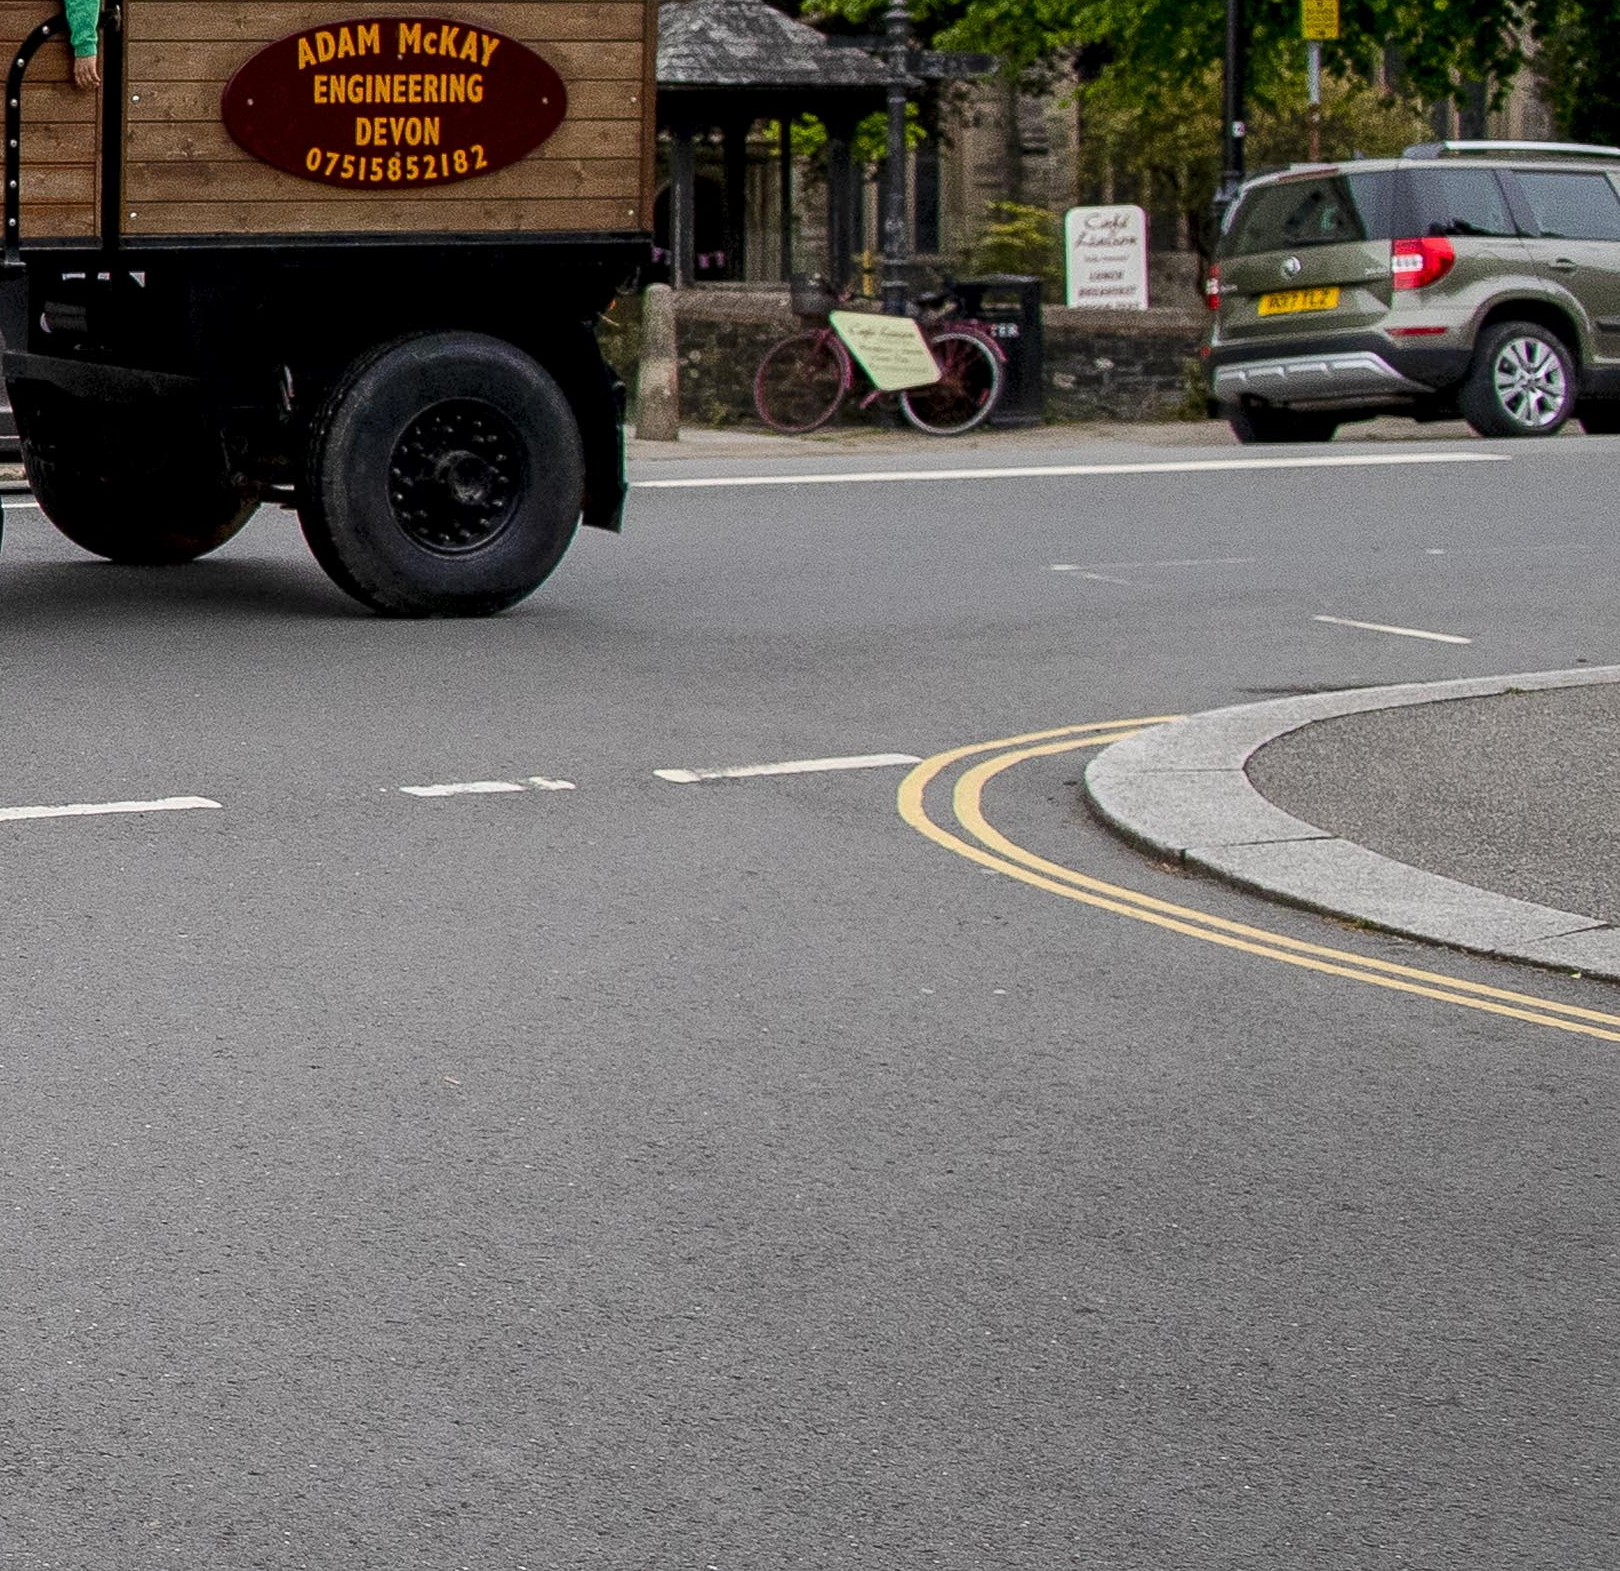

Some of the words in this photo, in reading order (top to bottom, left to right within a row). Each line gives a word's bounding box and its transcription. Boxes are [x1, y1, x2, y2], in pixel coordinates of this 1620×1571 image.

[298, 23, 380, 70] ADAM
[398, 23, 500, 67] McKAY
[313, 74, 483, 104] ENGINEERING
[355, 117, 440, 146] DEVON
[305, 145, 487, 181] 07515852182
